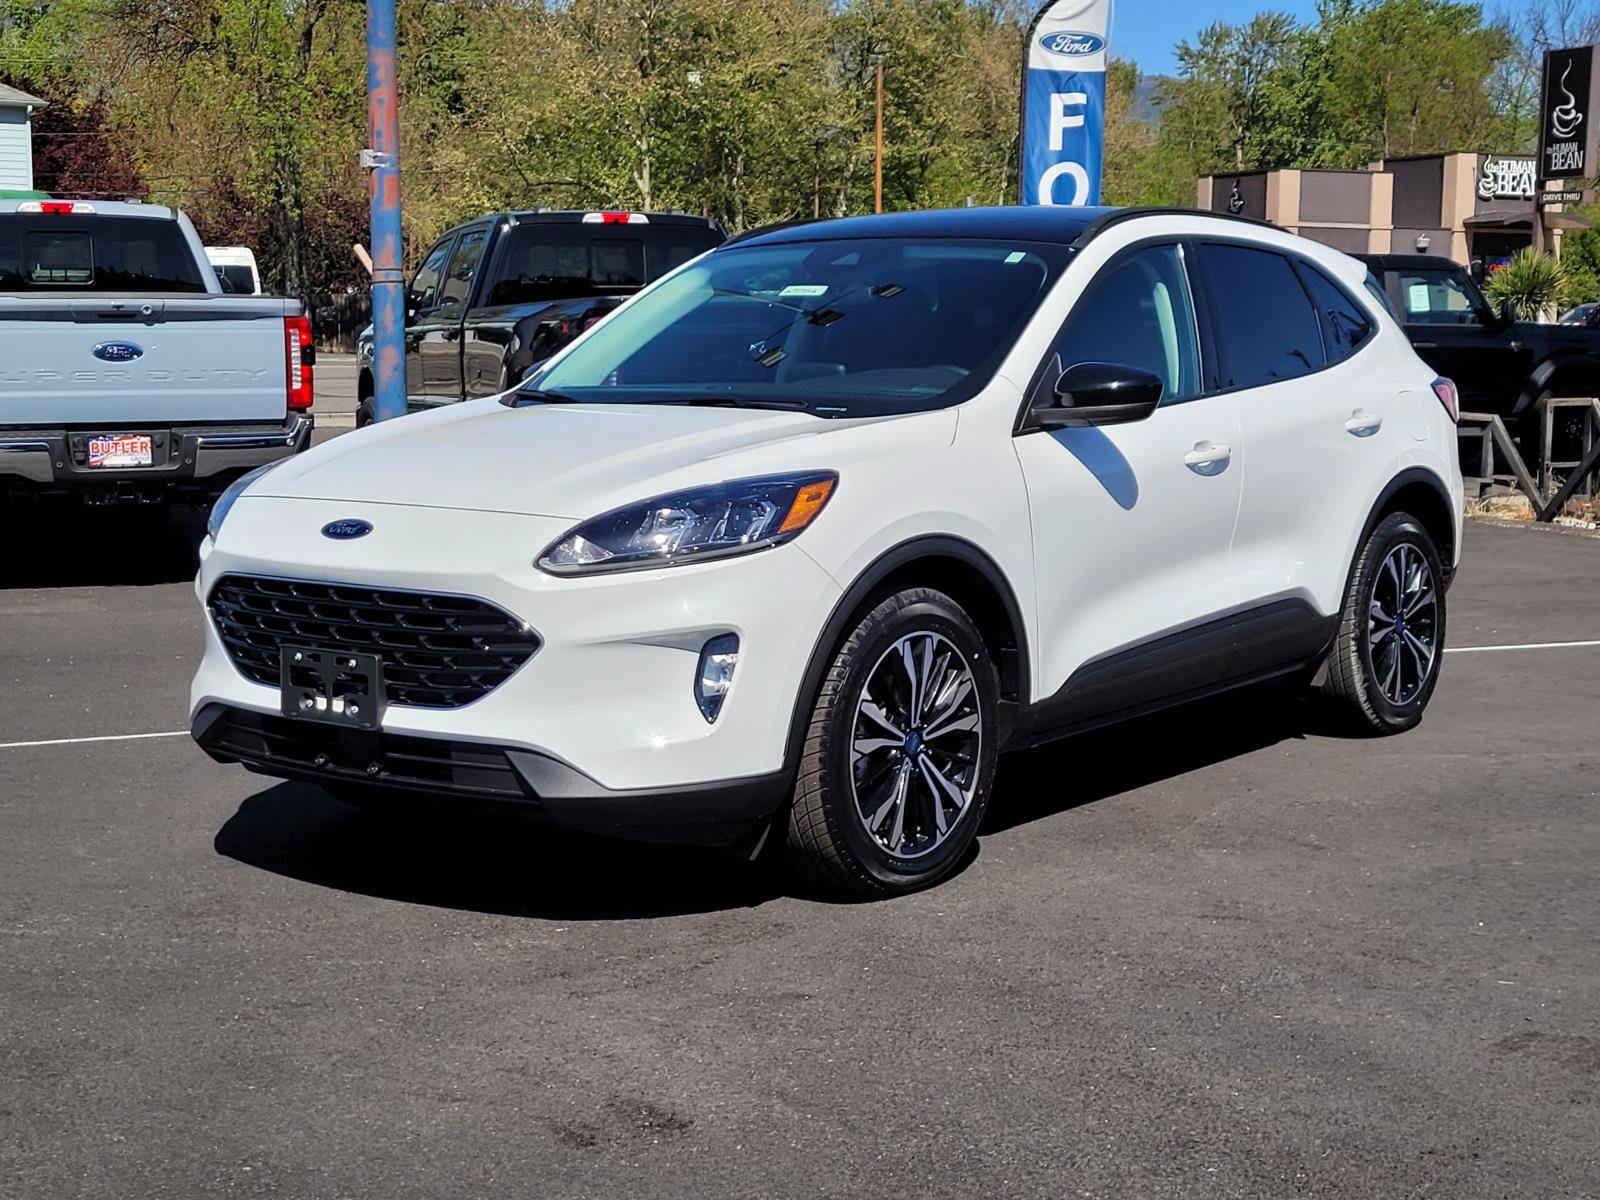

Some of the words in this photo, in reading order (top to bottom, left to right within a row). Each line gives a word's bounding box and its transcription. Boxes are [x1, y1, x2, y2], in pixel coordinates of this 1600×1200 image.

[1051, 34, 1094, 53] Ford
[1552, 142, 1579, 152] HUMAN
[1551, 150, 1584, 170] BEAN
[1498, 160, 1537, 174] HUMAN
[1543, 193, 1562, 201] DRIVE
[1563, 192, 1581, 200] THRU
[147, 369, 268, 382] DUTY
[91, 441, 149, 454] BUTLER
